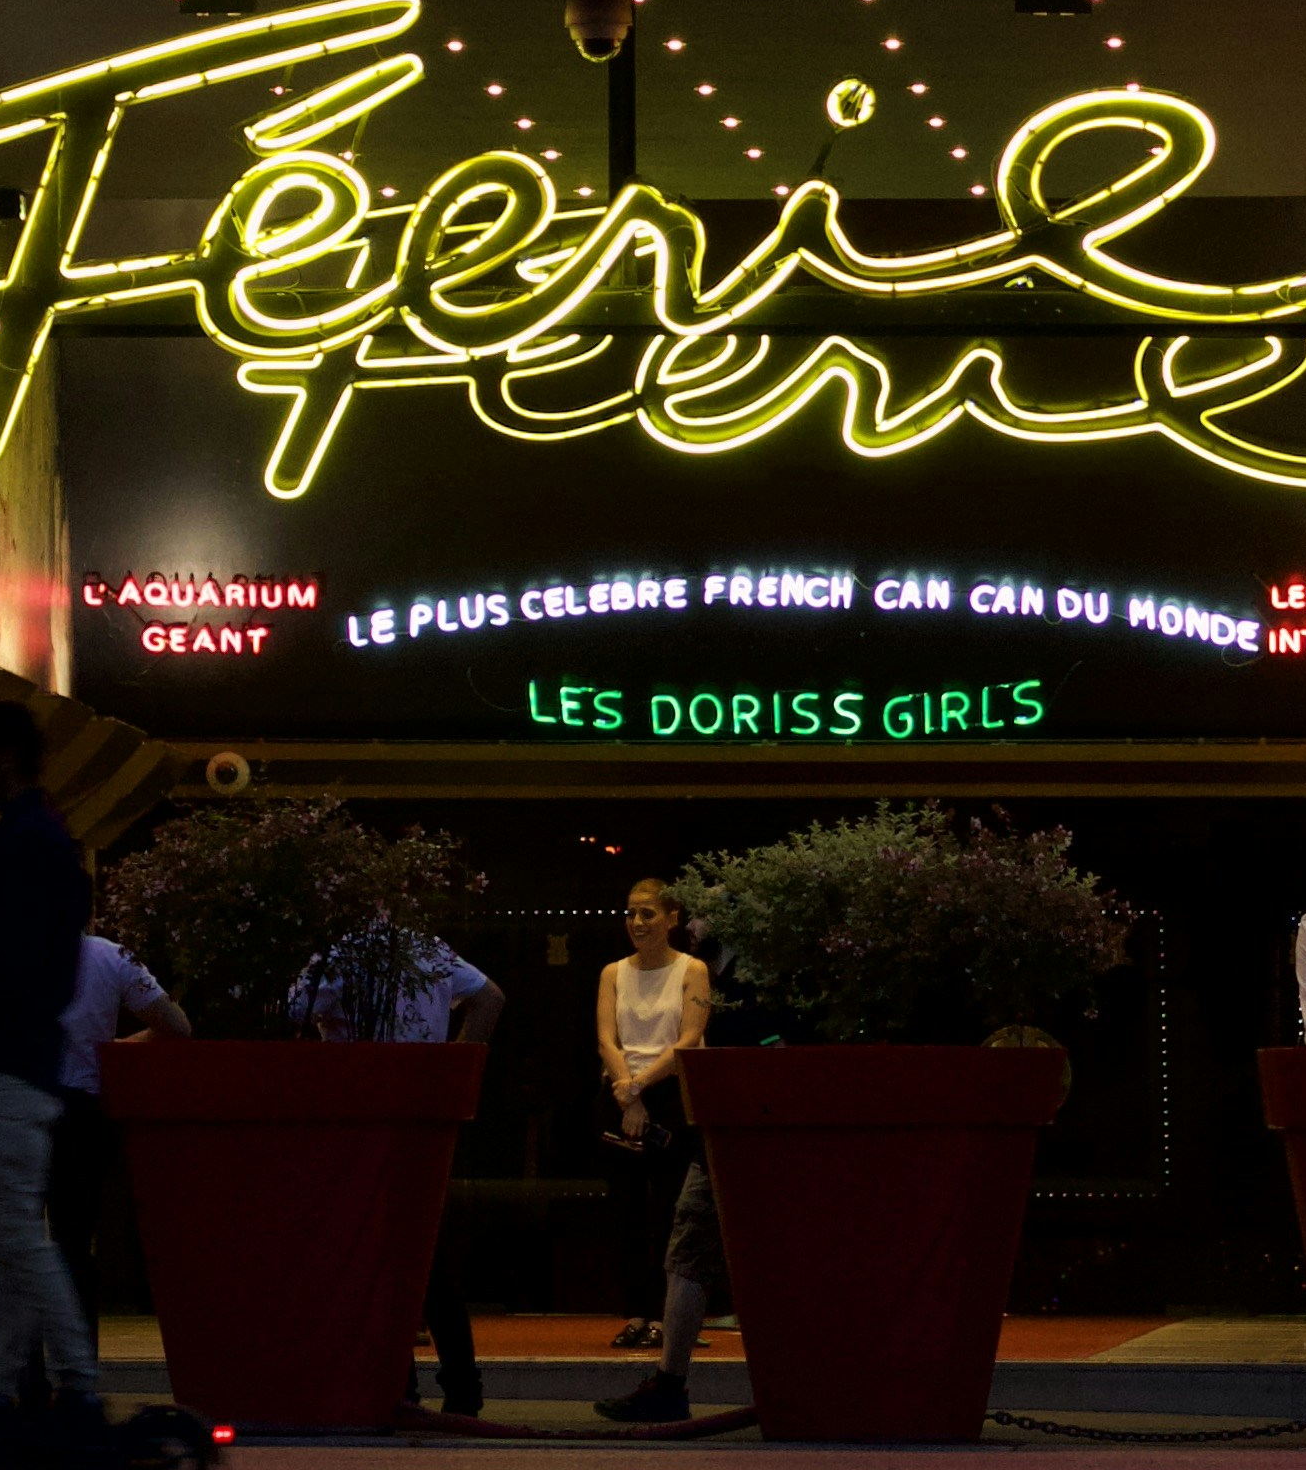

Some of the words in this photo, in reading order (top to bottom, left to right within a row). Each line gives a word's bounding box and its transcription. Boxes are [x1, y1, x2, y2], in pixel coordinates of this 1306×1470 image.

[141, 625, 269, 654] GEANT
[347, 608, 396, 648] LE
[409, 593, 510, 638] PLUS
[520, 578, 688, 621] CELEBRE
[703, 573, 853, 610] FRENCH
[873, 578, 951, 610] CAN
[968, 583, 1044, 616] CAN
[1056, 587, 1110, 624] DU
[1128, 597, 1261, 652] MONDE
[527, 679, 623, 730] LES
[649, 692, 865, 735] DORISS
[881, 678, 1045, 739] GIRLS
